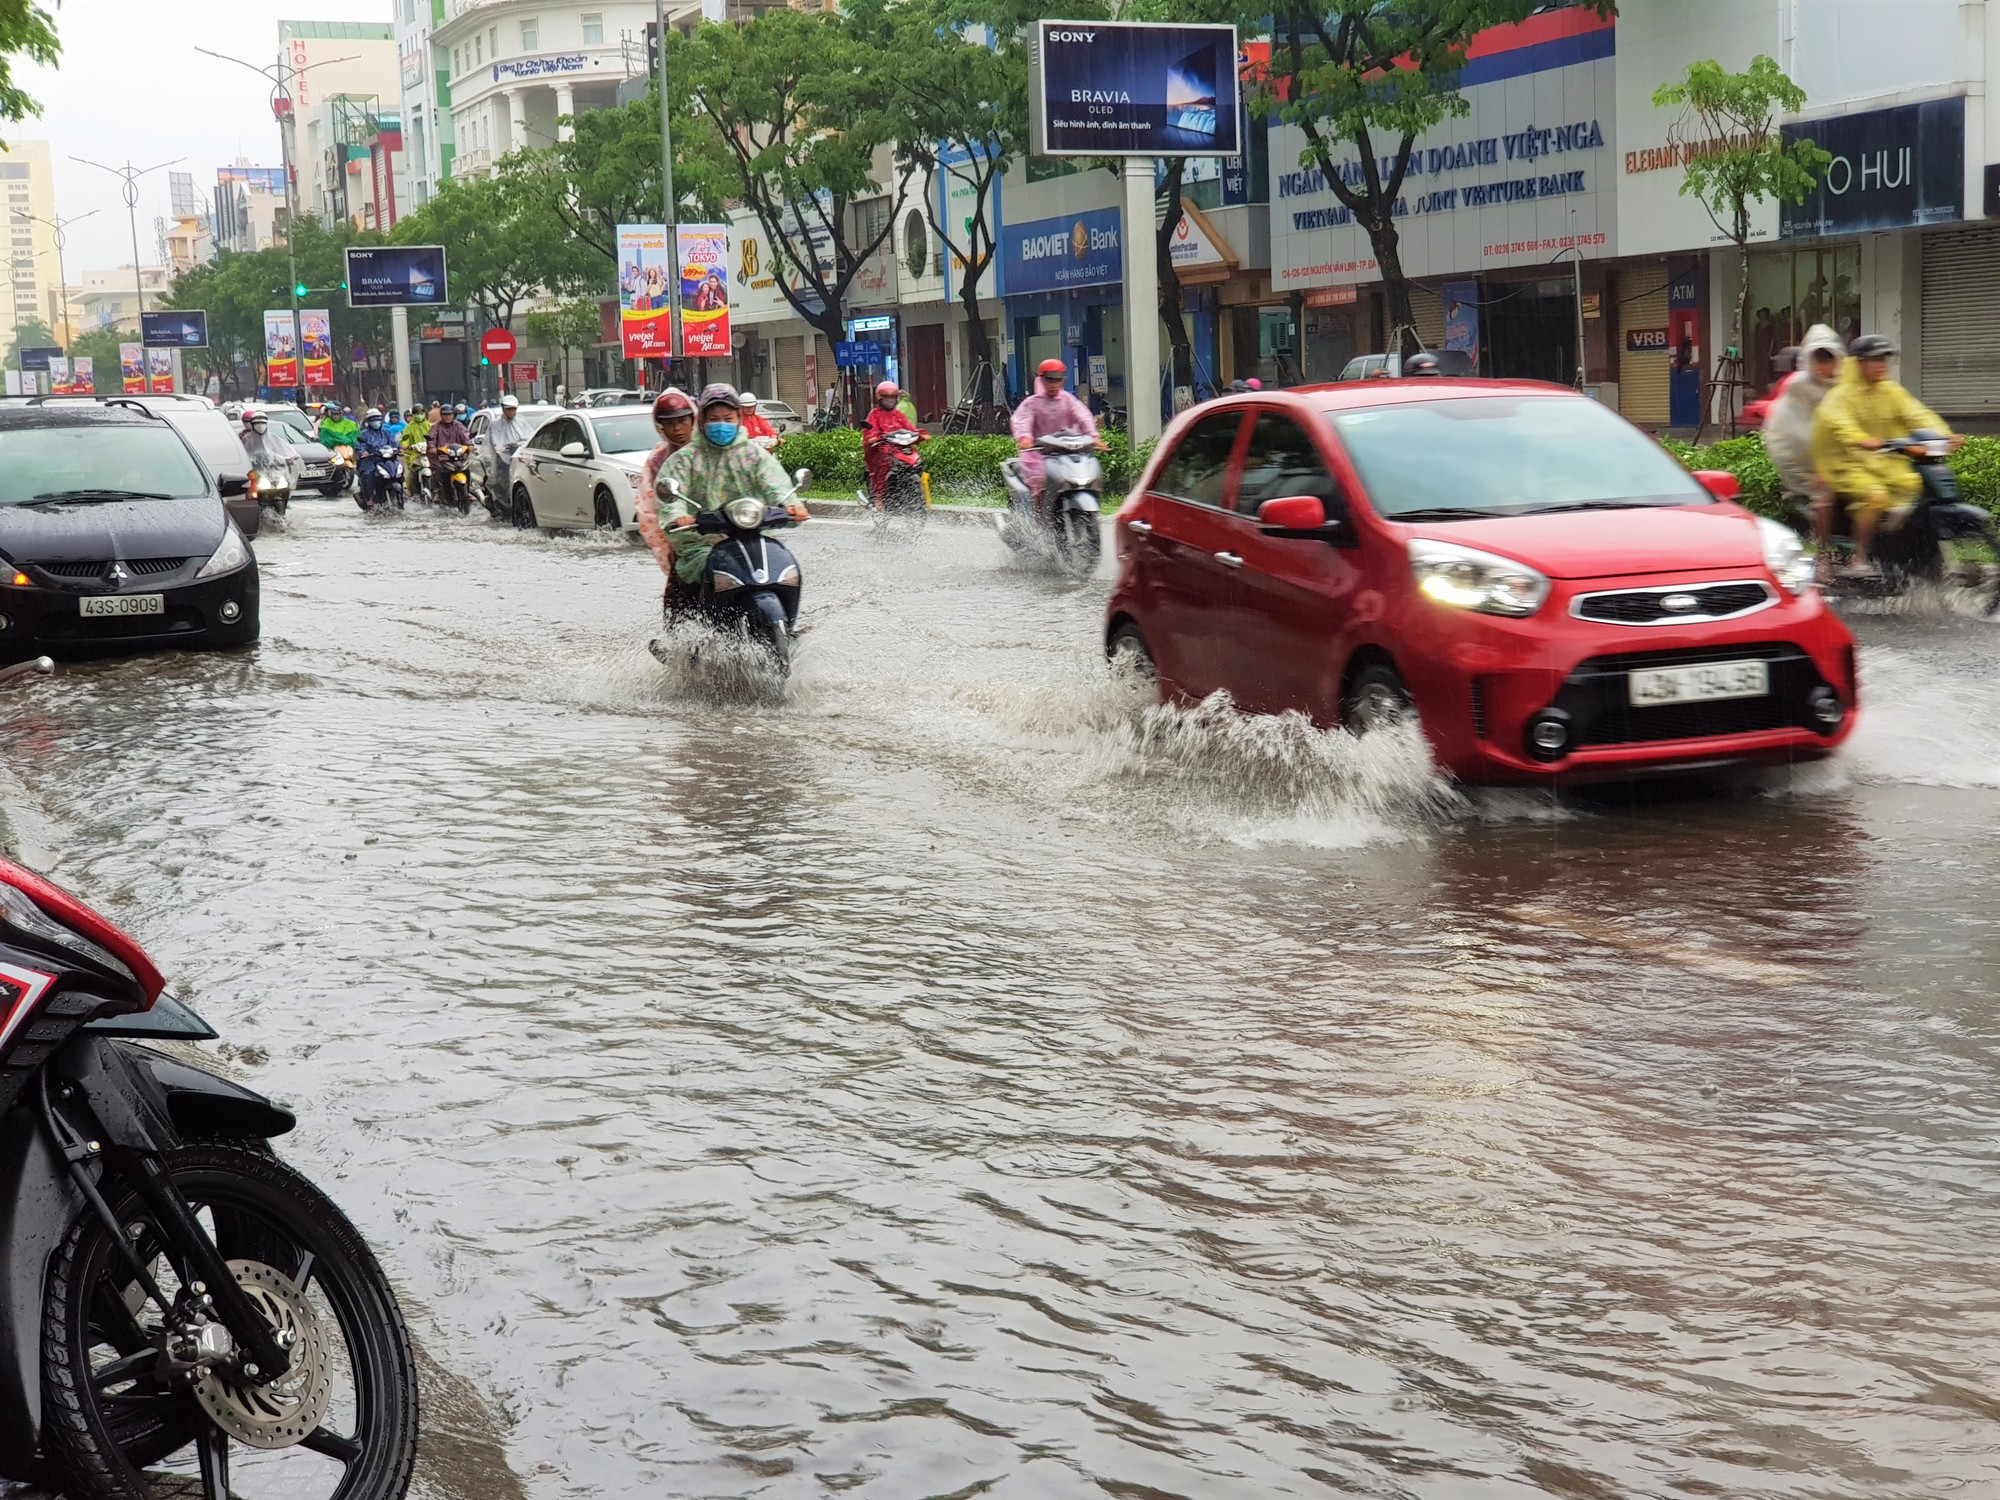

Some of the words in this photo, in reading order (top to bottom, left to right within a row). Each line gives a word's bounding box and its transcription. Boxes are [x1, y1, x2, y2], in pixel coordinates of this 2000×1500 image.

[1050, 31, 1095, 43] SONY
[294, 40, 308, 105] HOTEL
[560, 63, 584, 72] Nam
[1071, 89, 1131, 104] BRAVIA
[1088, 106, 1114, 114] OLED
[1052, 119, 1068, 129] Siêu
[1069, 120, 1086, 129] hình
[1130, 122, 1151, 130] thanh
[1426, 137, 1498, 174] DOANH
[1624, 144, 1680, 175] ELEGANT
[1826, 155, 1852, 195] O
[1861, 147, 1910, 191] HUI
[1460, 176, 1537, 207] VENTURE
[1538, 170, 1586, 198] BANK
[1022, 232, 1070, 260] BAOVIET
[1090, 224, 1118, 250] Bank
[1511, 242, 1526, 254] 3745
[1576, 234, 1593, 246] 3745
[688, 252, 718, 264] TOKYO
[1672, 284, 1695, 300] ATM
[1067, 326, 1080, 339] ATM
[1632, 332, 1666, 346] VRB
[85, 598, 158, 614] 43S-0909
